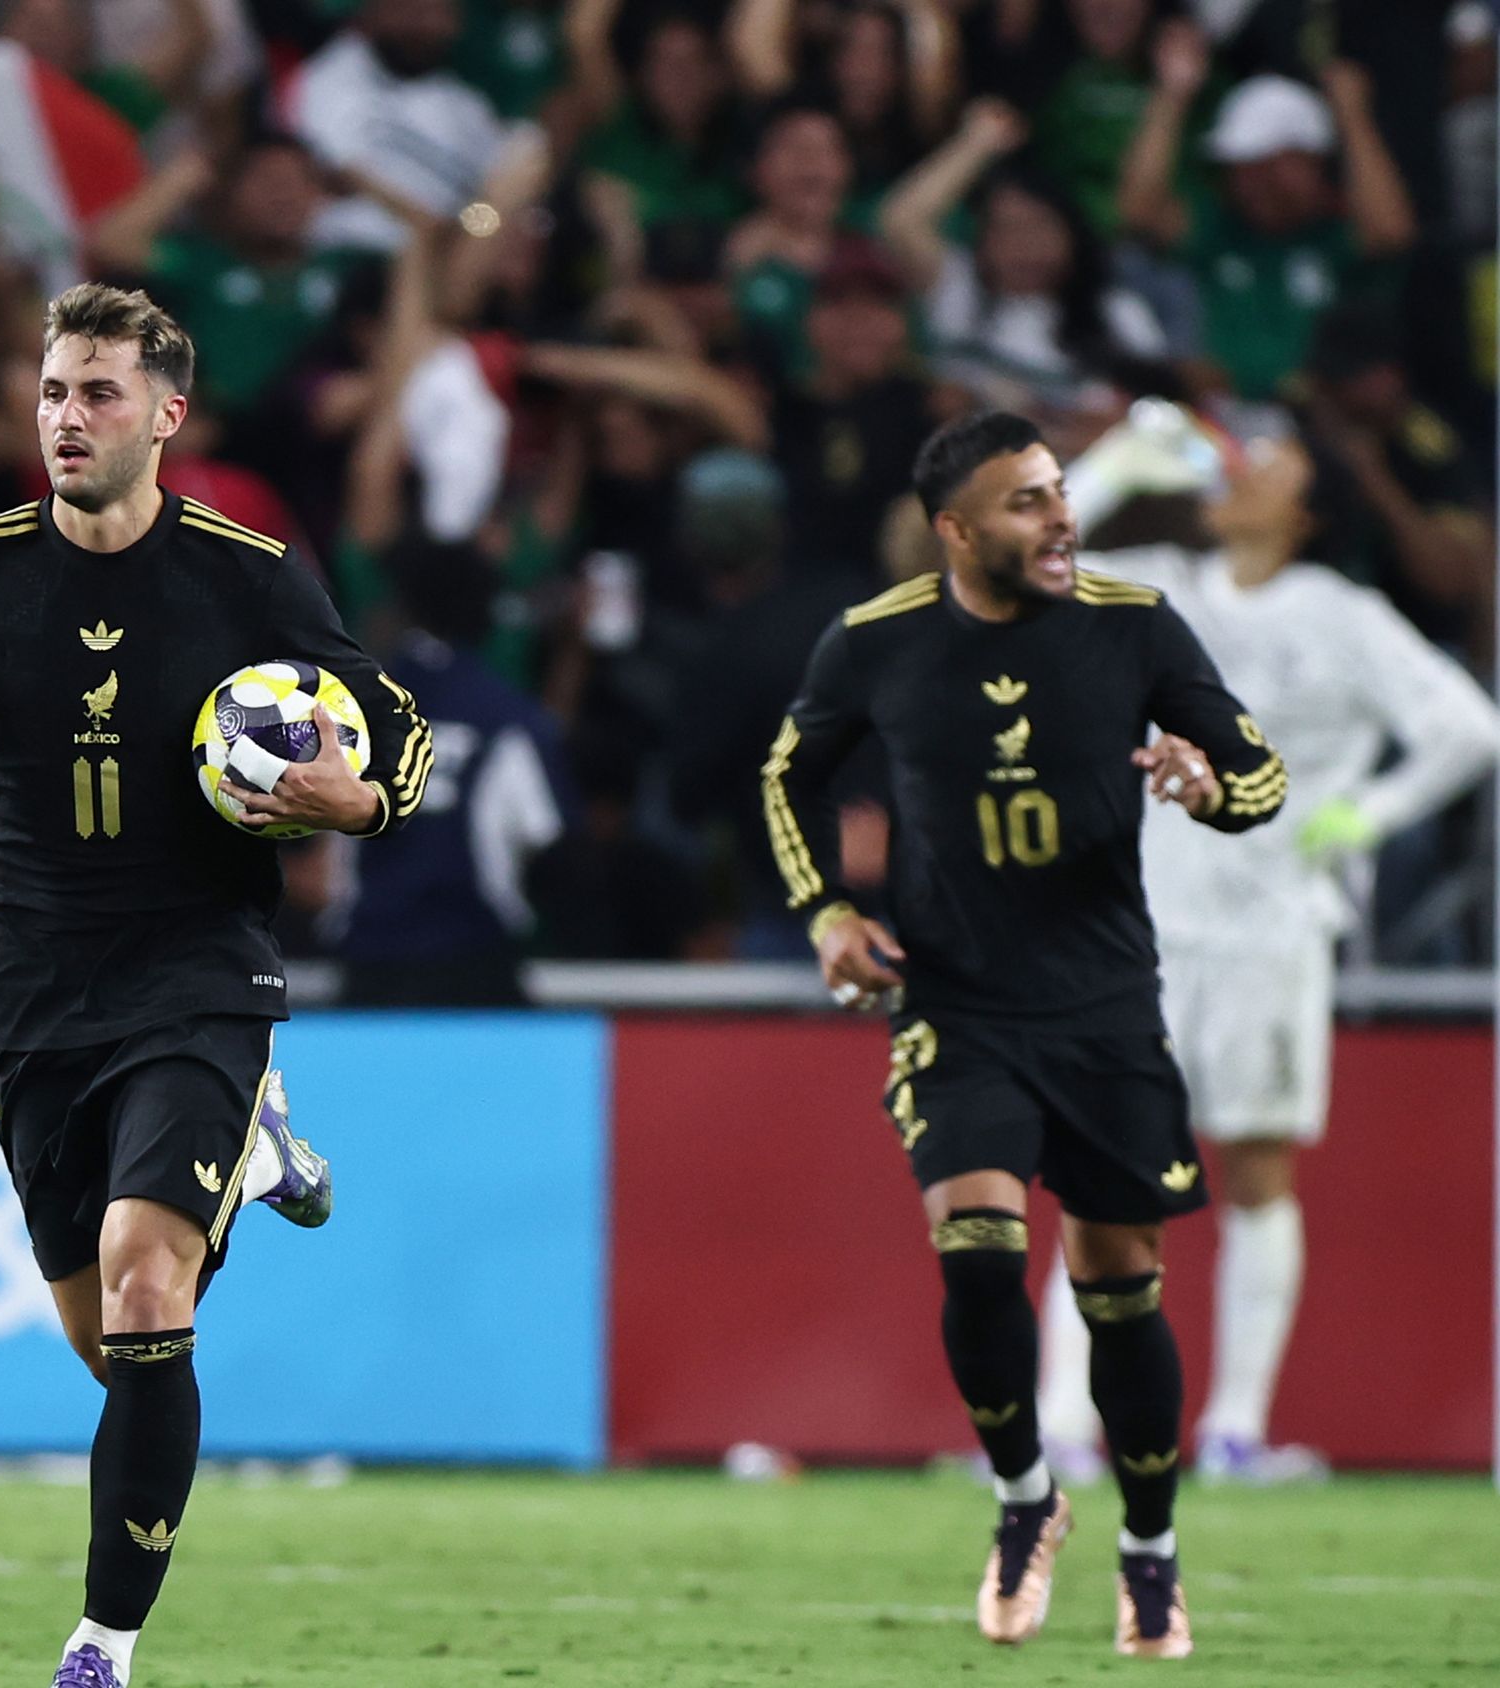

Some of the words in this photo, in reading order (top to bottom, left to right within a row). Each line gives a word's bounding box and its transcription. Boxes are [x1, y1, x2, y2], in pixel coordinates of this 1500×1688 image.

[73, 730, 120, 744] MÉXICO
[73, 755, 121, 840] 11
[975, 788, 1059, 868] 10
